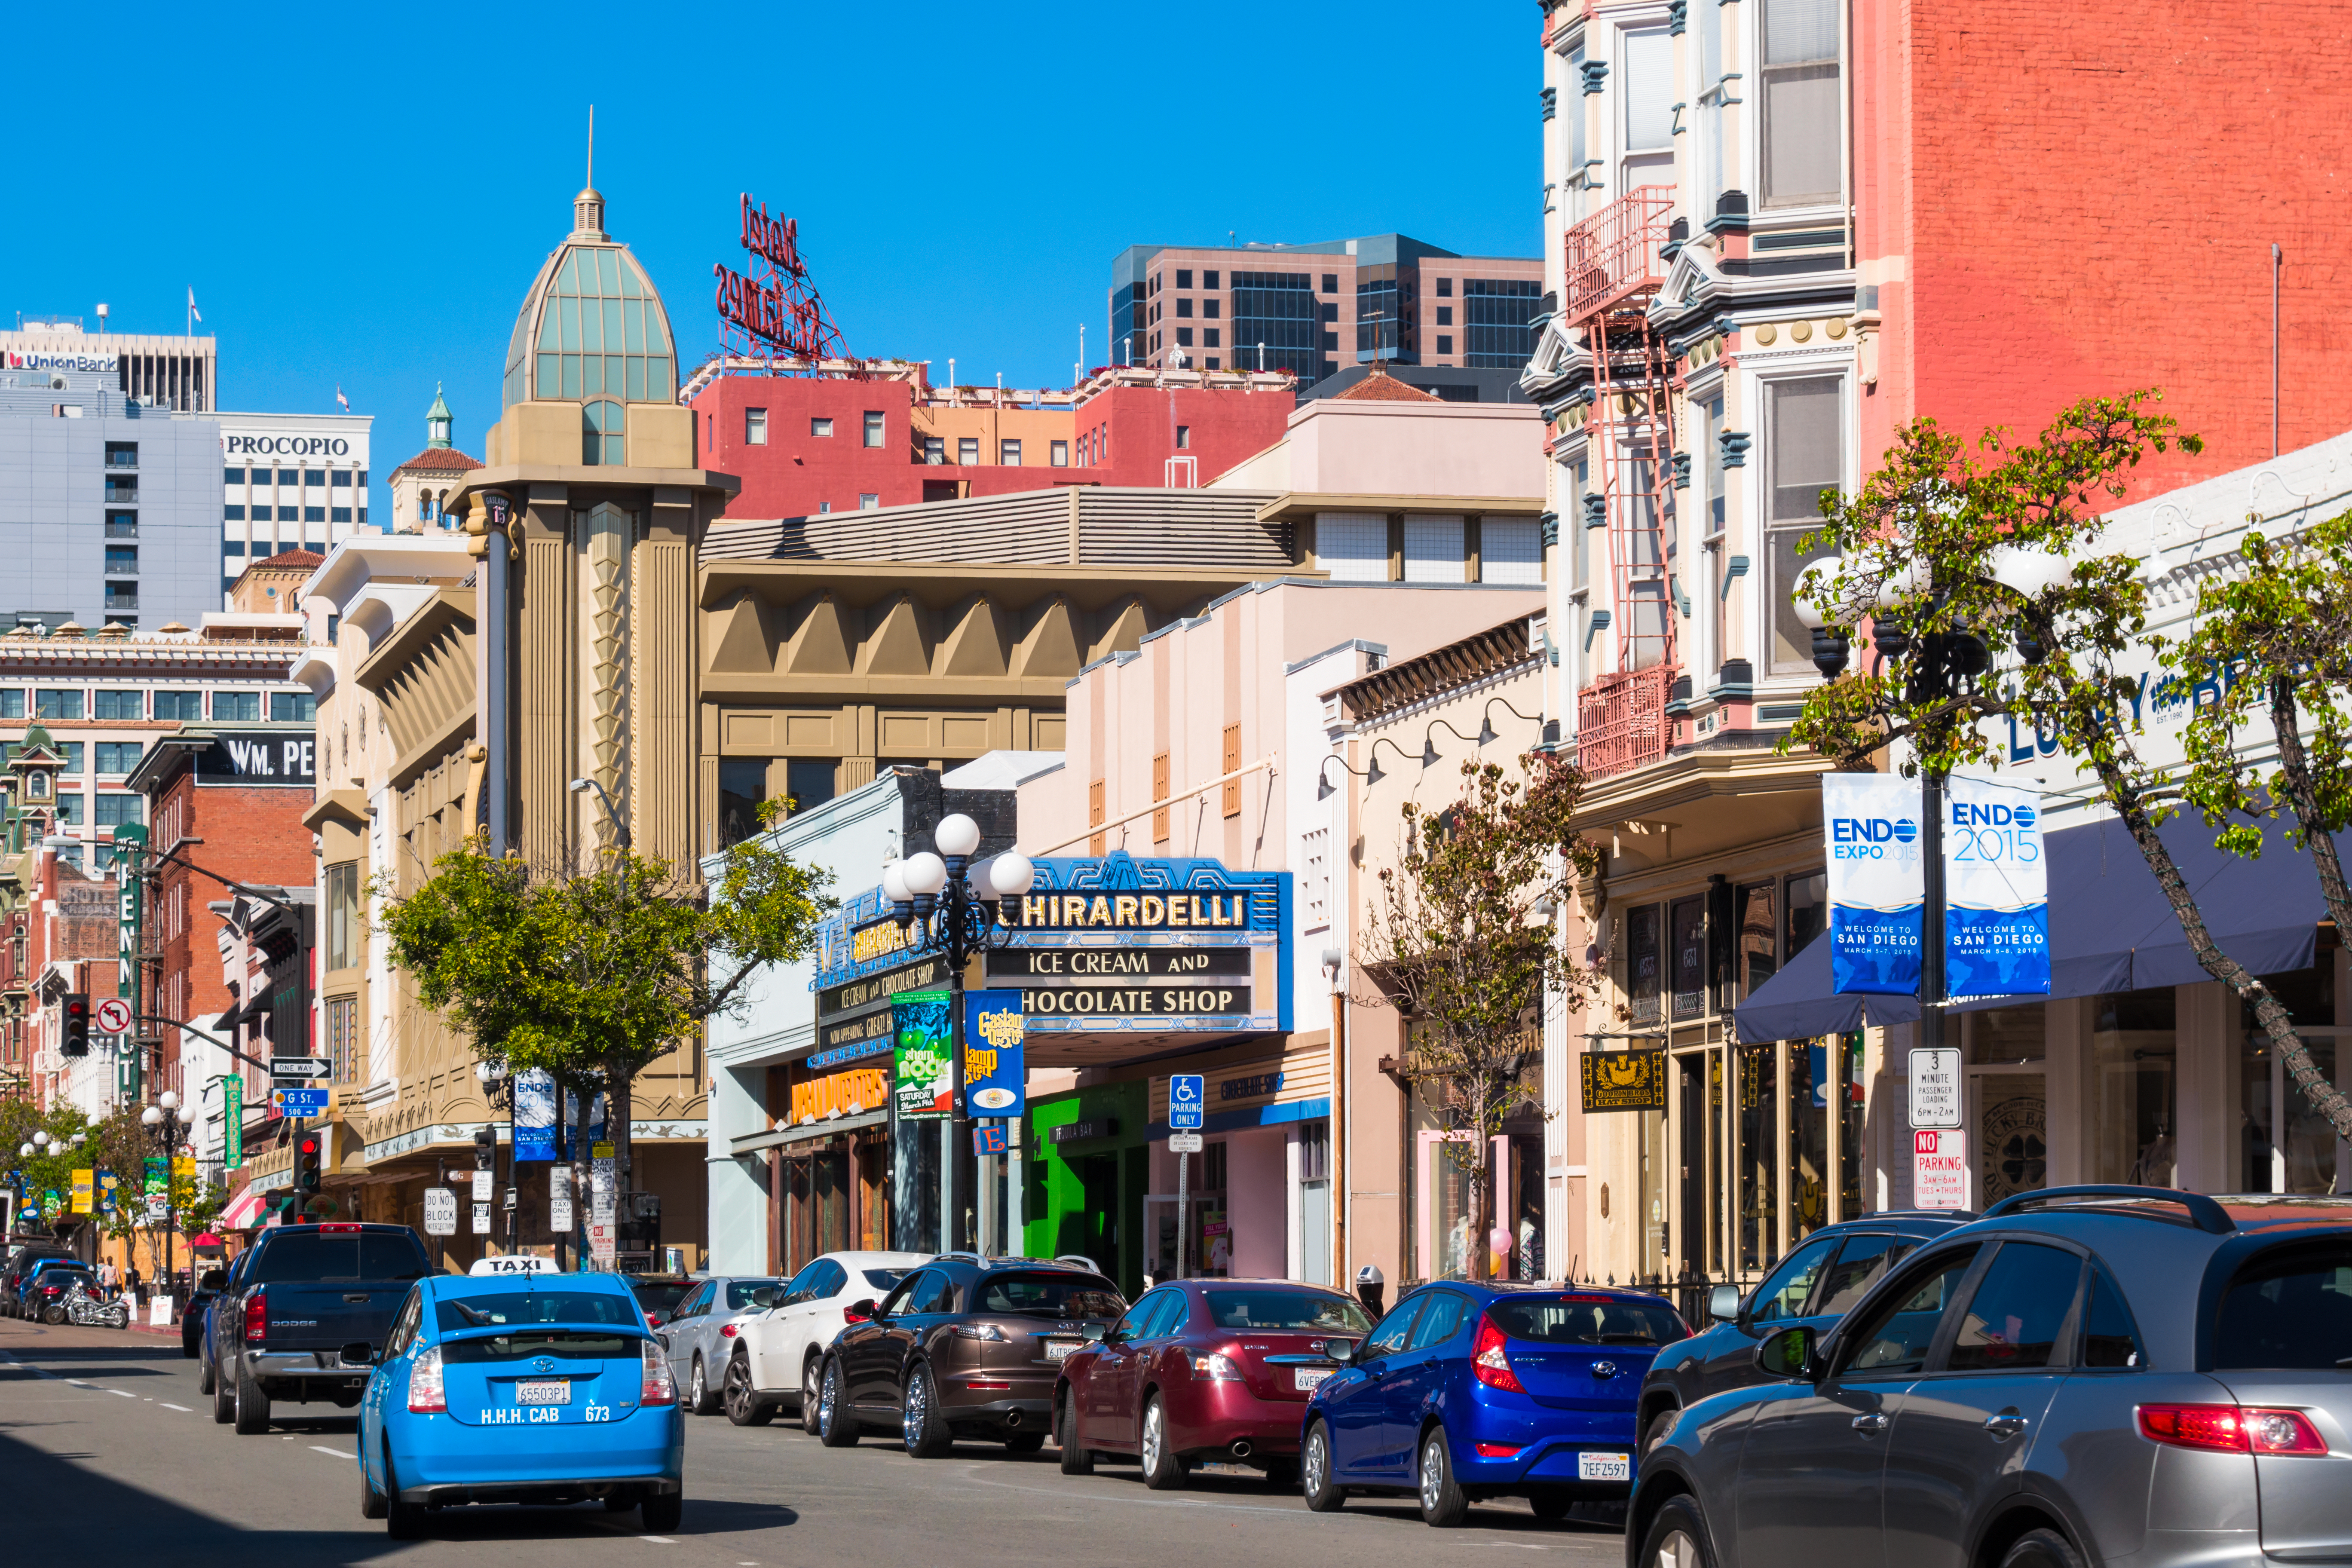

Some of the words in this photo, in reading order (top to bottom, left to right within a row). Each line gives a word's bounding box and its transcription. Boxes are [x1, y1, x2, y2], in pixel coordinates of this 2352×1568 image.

[27, 355, 117, 372] UnionBank
[227, 435, 349, 456] PROCOPIO
[2170, 711, 2183, 720] 1990
[1954, 828, 2038, 862] 2015
[1838, 934, 1865, 944] SAN
[1874, 935, 1917, 946] DIEGO
[1954, 935, 1984, 946] SAN
[1994, 934, 2044, 944] DIEGO
[1030, 952, 1063, 974] ICE
[1071, 952, 1149, 974] CREAM
[1168, 954, 1209, 972] AND
[850, 984, 867, 1006] CREAM
[870, 981, 879, 1001] AND
[882, 968, 916, 996] CHOCOLATE
[917, 963, 934, 986] SHOP
[1022, 991, 1152, 1013] HOCOLATE
[1164, 990, 1233, 1012] SHOP
[830, 1028, 840, 1044] NOW
[840, 1023, 864, 1041] APPEARING:
[867, 1014, 885, 1038] GREAT!
[905, 1047, 935, 1061] sham
[899, 1058, 949, 1078] ROCK
[1931, 1056, 1939, 1070] 3
[1921, 1074, 1949, 1084] MINUTE
[288, 1093, 295, 1104] G
[900, 1091, 931, 1101] SATURDAY
[1596, 1089, 1627, 1098] GOORIN
[518, 1093, 554, 1108] 2015
[901, 1100, 921, 1110] March
[922, 1098, 934, 1106] 14th
[1621, 1097, 1650, 1105] SHOP
[1171, 1102, 1201, 1113] PARKING
[1177, 1115, 1195, 1125] ONLY
[1056, 1127, 1077, 1141] TEQUILA
[1080, 1123, 1093, 1136] BAR
[1918, 1133, 1935, 1151] NO
[1919, 1157, 1961, 1171] PARKING
[427, 1195, 436, 1205] DO
[440, 1195, 454, 1205] NOT
[427, 1210, 454, 1221] BLOCK
[594, 1227, 602, 1235] NO
[489, 1260, 541, 1271] TAXI
[521, 1387, 567, 1400] 65503P1
[481, 1409, 525, 1424] H.H.H.
[529, 1408, 559, 1422] CAB
[585, 1406, 610, 1422] 673
[1583, 1463, 1626, 1476] 7EFZ597
